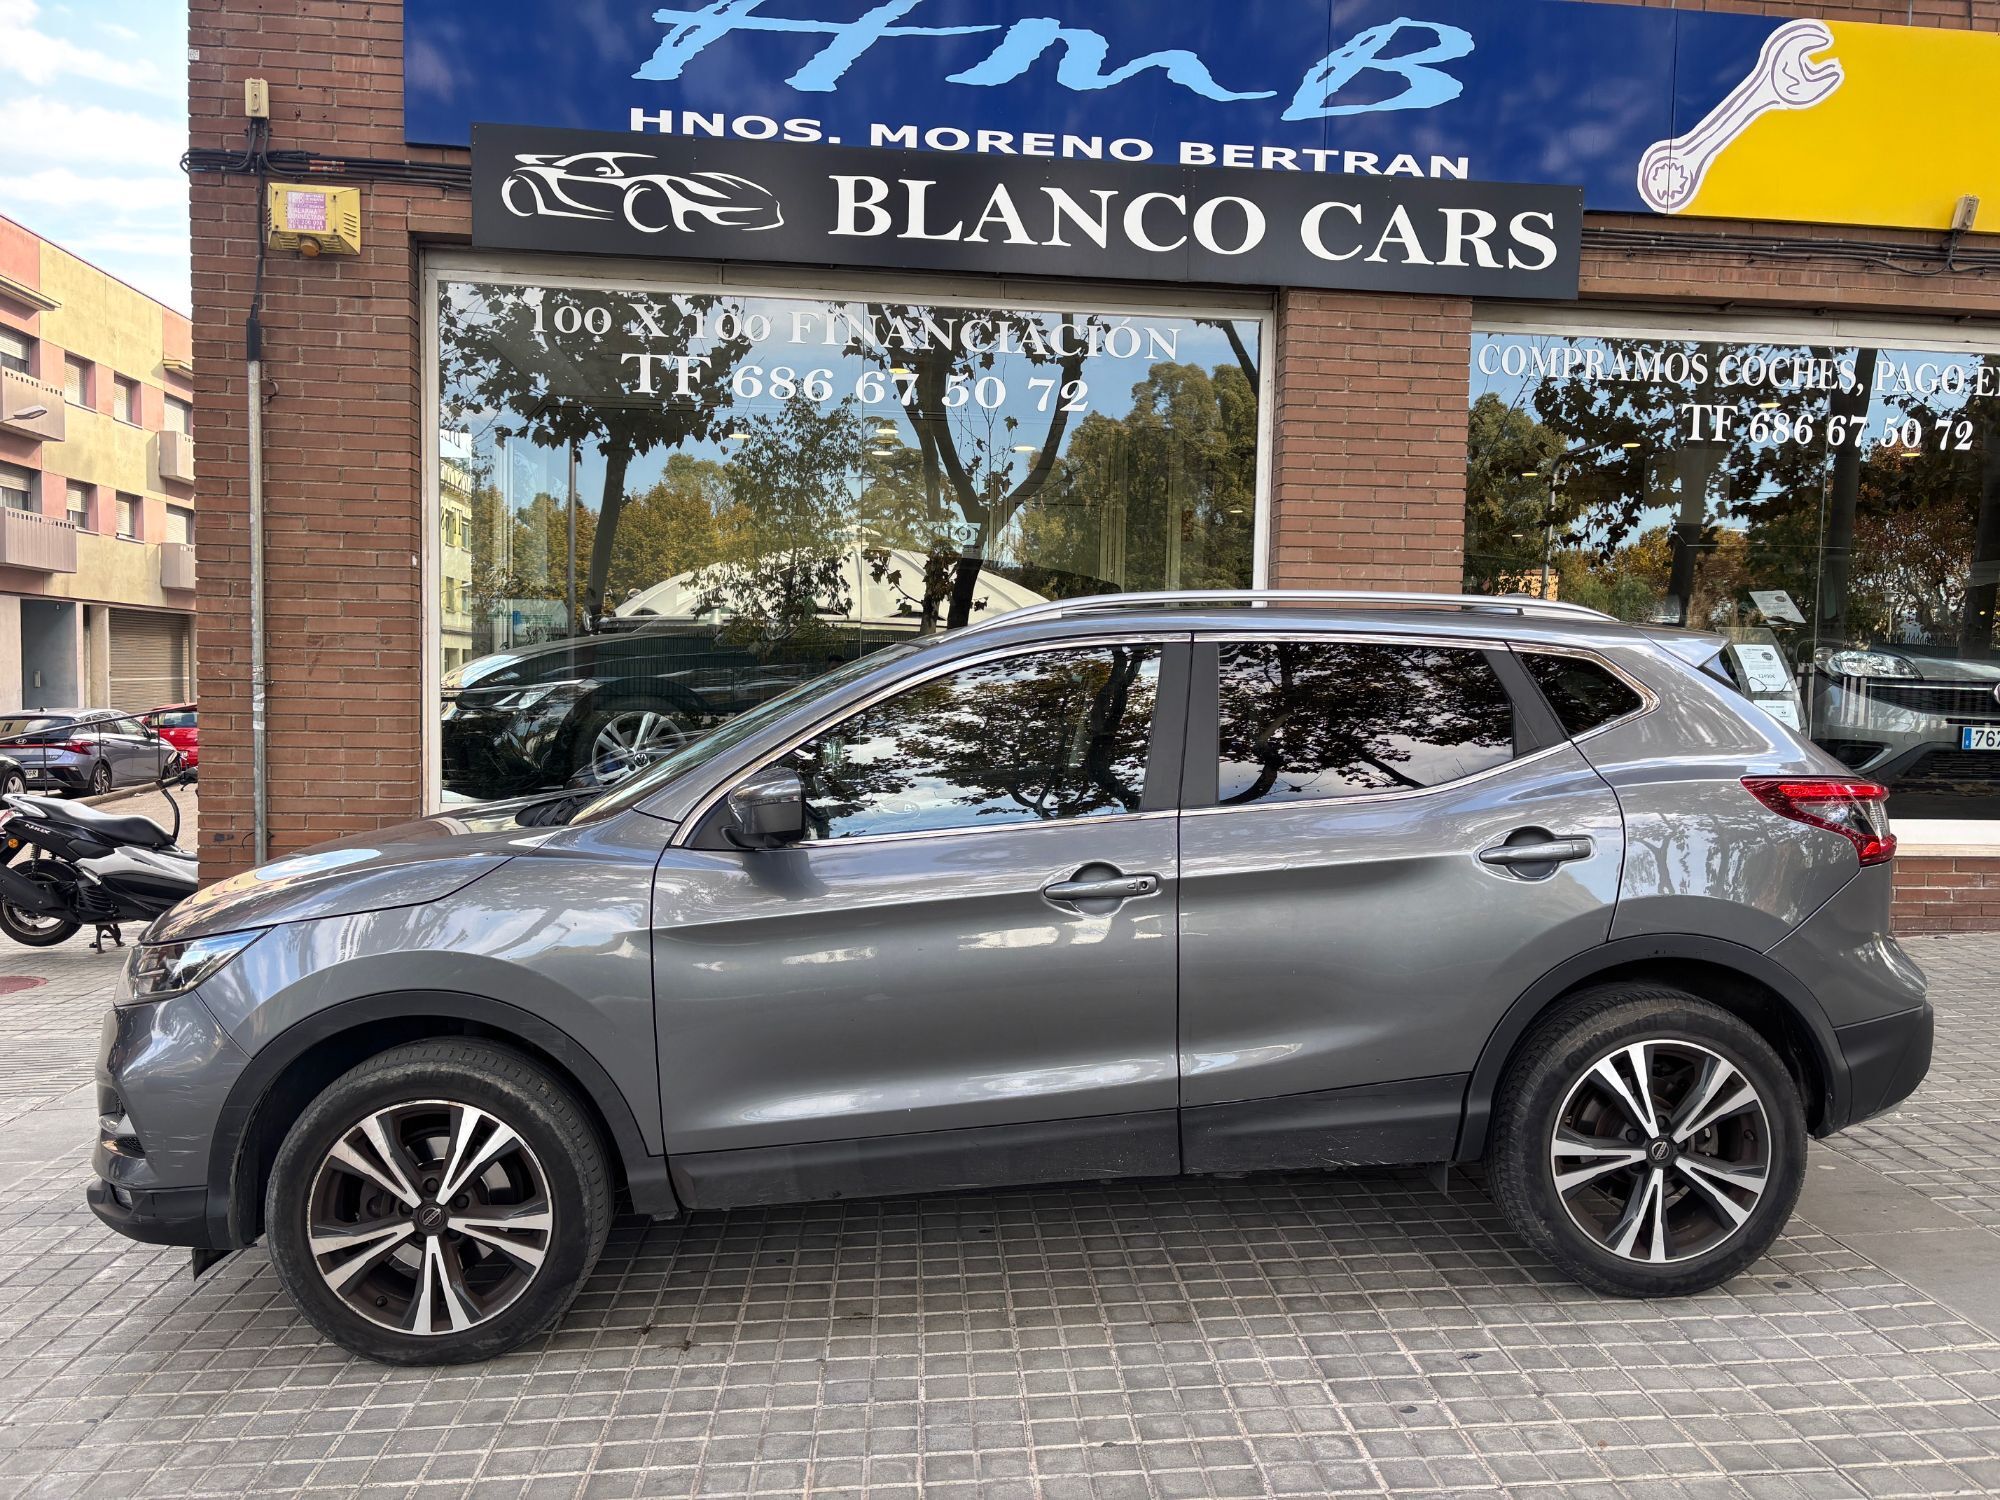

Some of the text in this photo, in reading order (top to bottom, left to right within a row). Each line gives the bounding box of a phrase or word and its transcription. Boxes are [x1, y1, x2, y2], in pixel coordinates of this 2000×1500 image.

[630, 108, 1469, 180] HNOS. MORENO BERTRAN
[828, 175, 1558, 271] BLANCO CARS
[532, 303, 613, 337] 100
[690, 311, 772, 344] 100
[788, 310, 1181, 362] FINANCIACIÓN
[620, 352, 1089, 413] TF 686 67 50 72
[1477, 344, 1709, 386] COMPRAMOS
[1719, 353, 1865, 396] COCHES,
[1872, 360, 1966, 396] PAGO
[1681, 403, 1974, 451] TF 686 67 50 72
